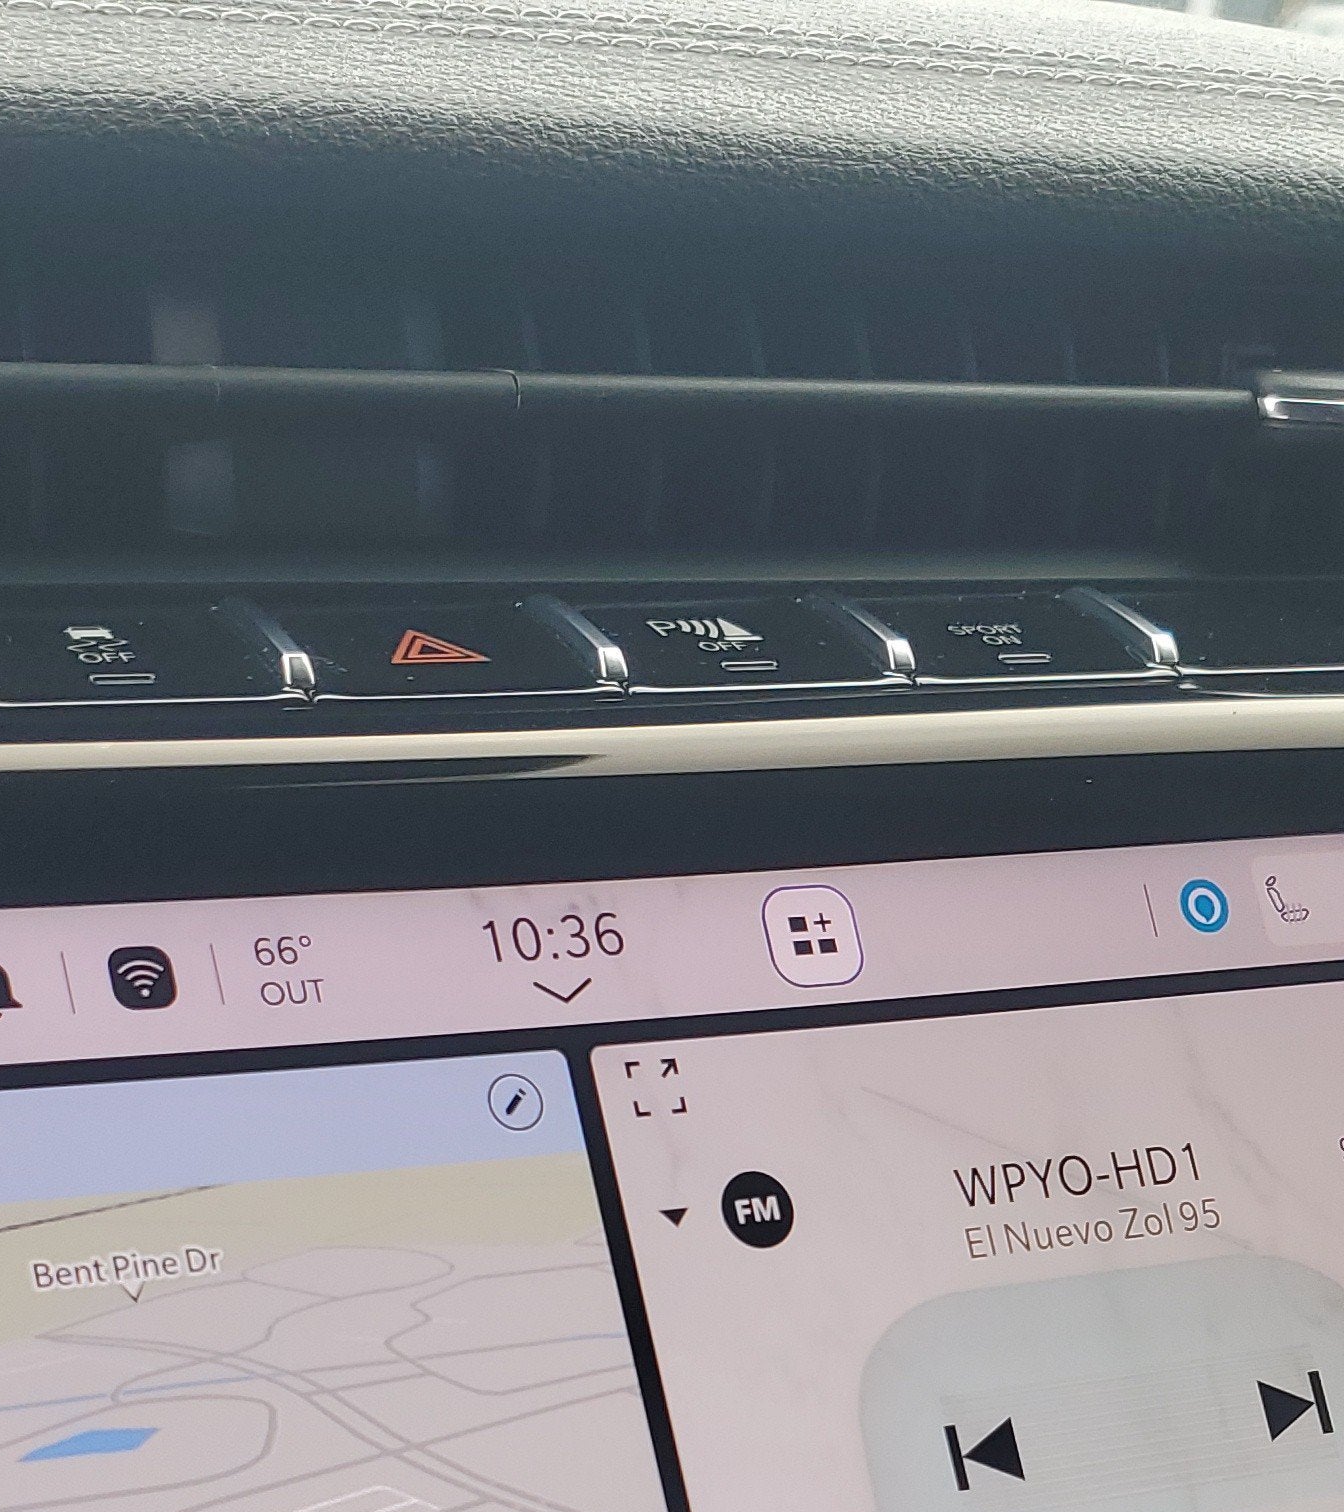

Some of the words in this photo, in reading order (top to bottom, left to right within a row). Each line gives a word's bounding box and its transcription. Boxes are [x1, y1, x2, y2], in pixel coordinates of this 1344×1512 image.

[947, 624, 1022, 636] SPORT
[982, 635, 1023, 646] ON
[78, 651, 137, 664] OFF
[698, 641, 748, 652] OFF
[254, 934, 313, 966] 66°
[482, 911, 626, 964] 10:36
[260, 978, 325, 1007] OUT
[953, 1142, 1200, 1207] WPYO-HD1
[734, 1195, 782, 1226] FM
[964, 1224, 997, 1259] El
[1003, 1221, 1113, 1254] Nuevo
[1118, 1202, 1174, 1240] Zol
[1179, 1198, 1221, 1232] 95
[33, 1260, 107, 1288] Bent
[112, 1253, 177, 1281] Pine
[185, 1248, 220, 1273] Dr
